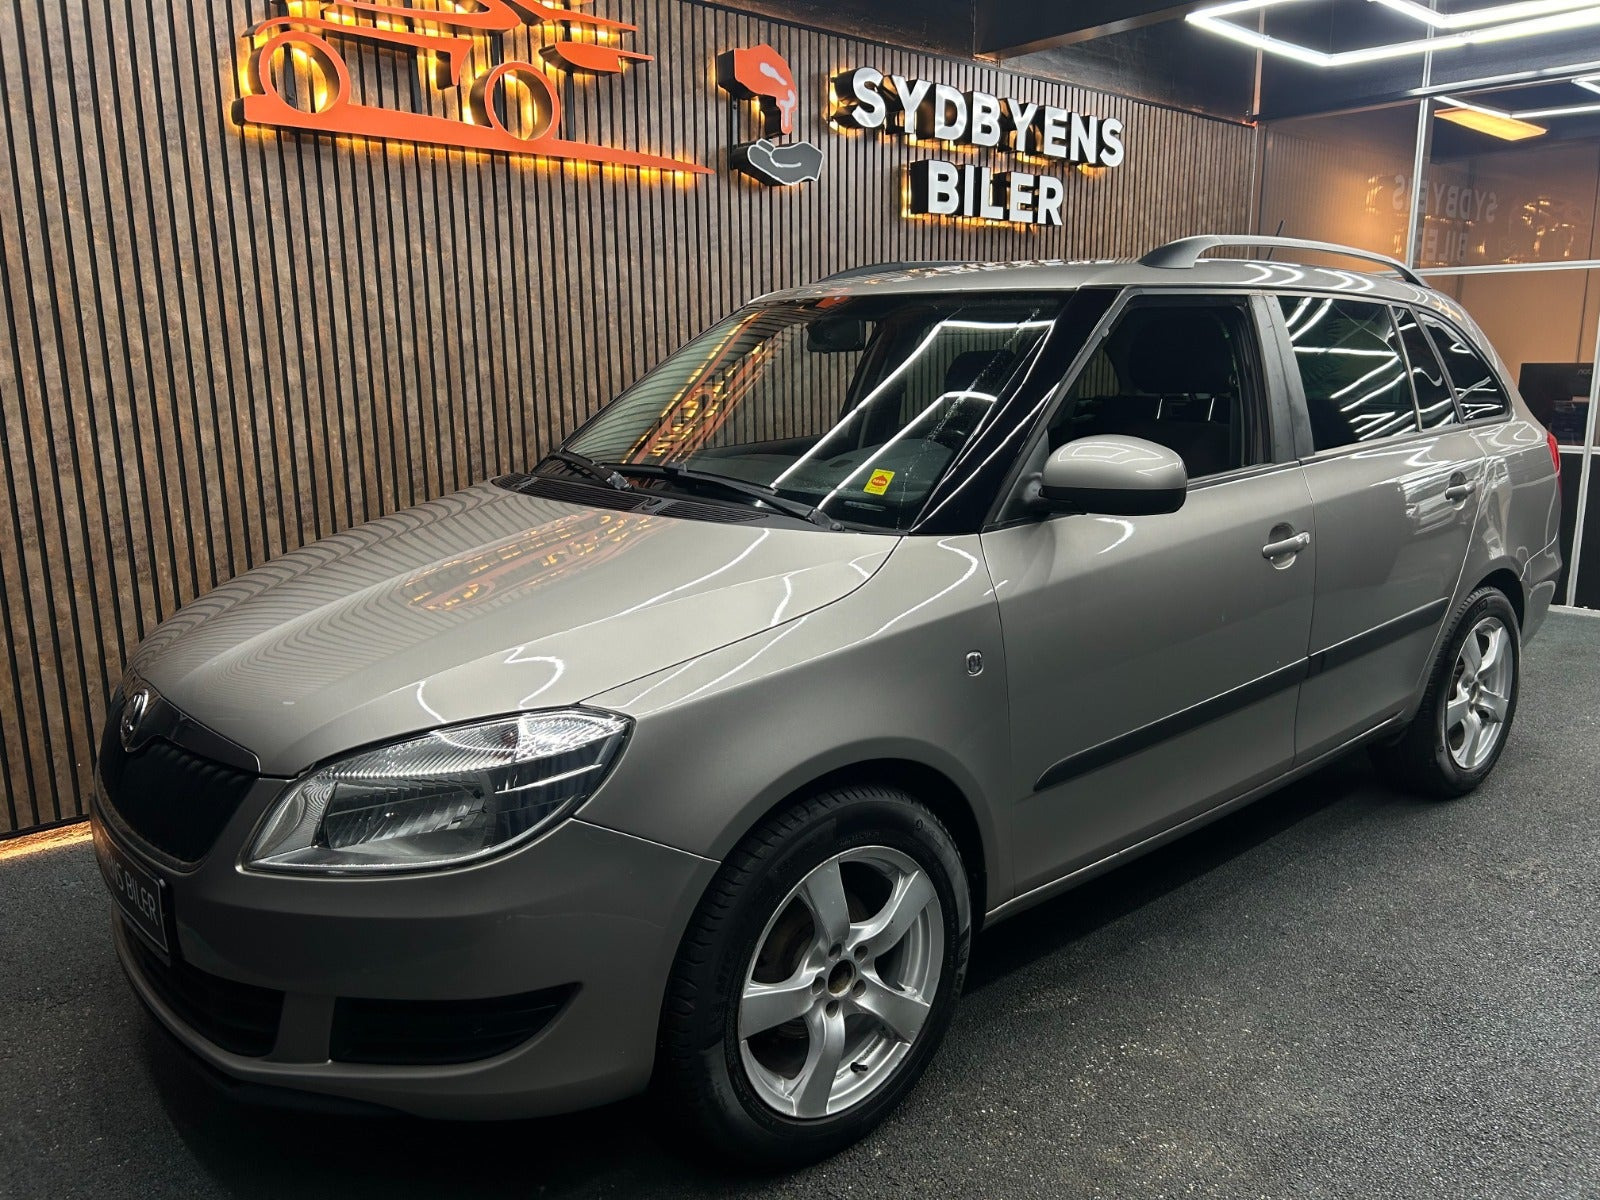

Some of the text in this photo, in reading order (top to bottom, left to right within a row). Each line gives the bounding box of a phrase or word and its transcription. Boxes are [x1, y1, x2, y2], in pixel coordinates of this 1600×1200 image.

[852, 67, 1125, 168] SYDBYENS
[927, 159, 1064, 227] BILER
[123, 870, 158, 926] BILER
